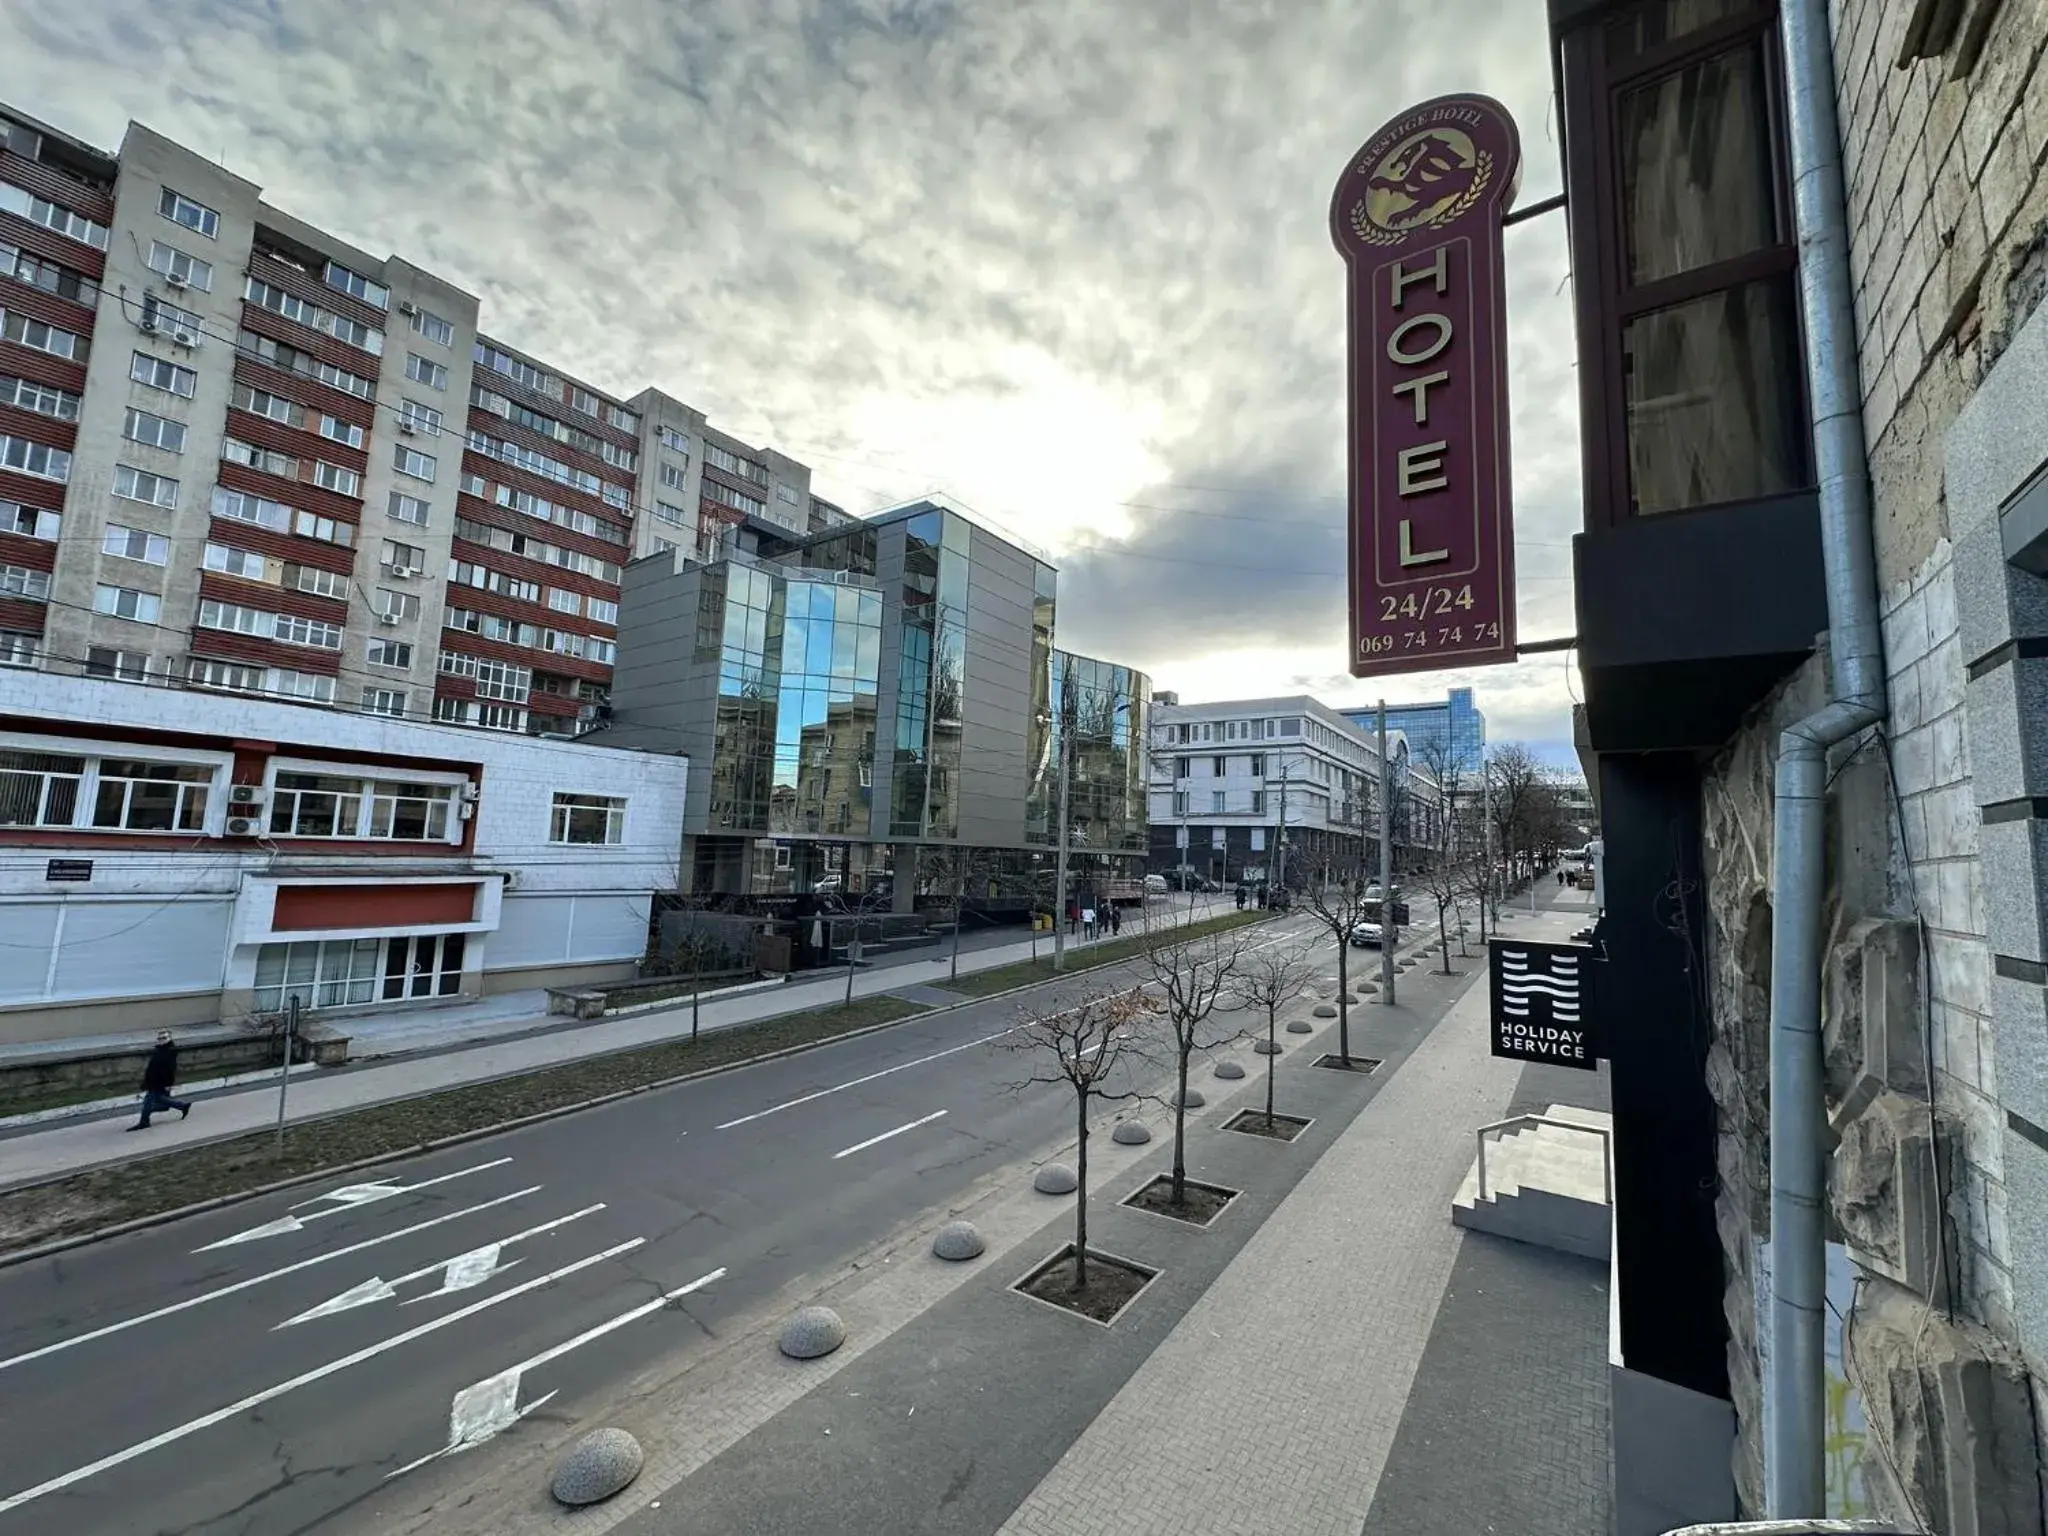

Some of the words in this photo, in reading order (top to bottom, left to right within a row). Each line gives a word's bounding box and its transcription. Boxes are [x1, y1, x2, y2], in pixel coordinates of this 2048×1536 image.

[1433, 107, 1483, 129] HOTEL
[1386, 246, 1453, 567] HOTEL
[1380, 584, 1475, 621] 24/24
[1360, 635, 1394, 654] 069
[1404, 630, 1428, 649] 74
[1438, 625, 1463, 645] 74
[1474, 621, 1499, 641] 74
[1500, 1021, 1584, 1044] HOLIDAY
[1502, 1035, 1585, 1059] SERVICE
